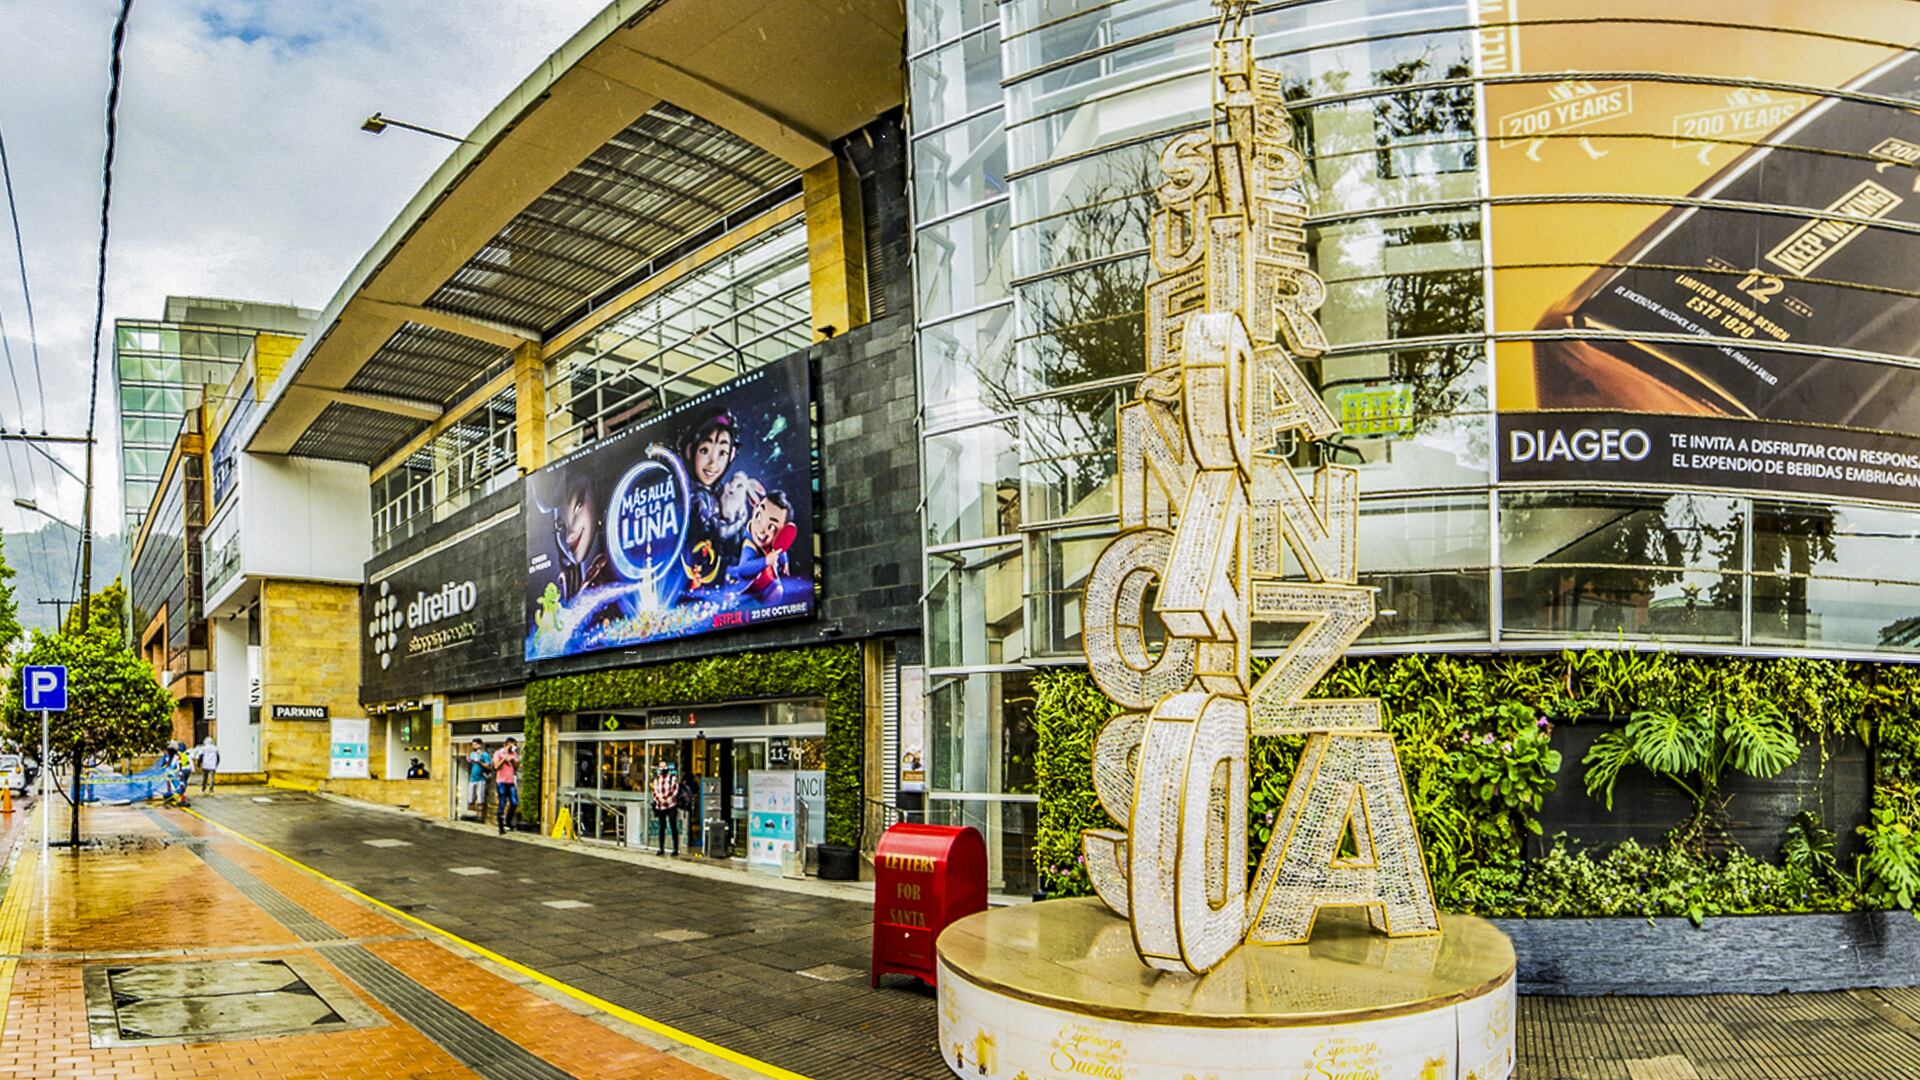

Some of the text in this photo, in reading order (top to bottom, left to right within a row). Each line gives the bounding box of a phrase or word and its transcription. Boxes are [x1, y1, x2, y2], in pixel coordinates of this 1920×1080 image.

[1510, 92, 1622, 136] 200 YEARS
[1683, 105, 1795, 137] 200 YEARS
[1881, 143, 1920, 161] 200
[1777, 187, 1891, 271] KEEP WAKING
[1736, 268, 1784, 304] 12
[1675, 274, 1714, 299] LIMITED
[1715, 294, 1757, 321] EDITION
[1753, 315, 1791, 341] DESIGN
[1721, 315, 1755, 338] 1820
[1510, 429, 1651, 462] DIAGEO
[1670, 433, 1920, 469] TE INVITA A DISFRUTAR CON RESPONS
[1672, 453, 1920, 488] EL EXPENDIO DE BEBIDAS EMBRIAGAN
[622, 474, 676, 515] MÁS ALLÁ
[635, 502, 661, 519] DE LA
[622, 502, 679, 550] LUNA
[713, 602, 807, 628] NETFLIX 23 DE OCTUBRE
[31, 671, 58, 704] P
[276, 706, 324, 718] PARKING
[651, 713, 682, 725] entrada
[885, 853, 936, 872] LETTERS
[897, 882, 921, 900] FOR
[890, 908, 926, 928] SANTA
